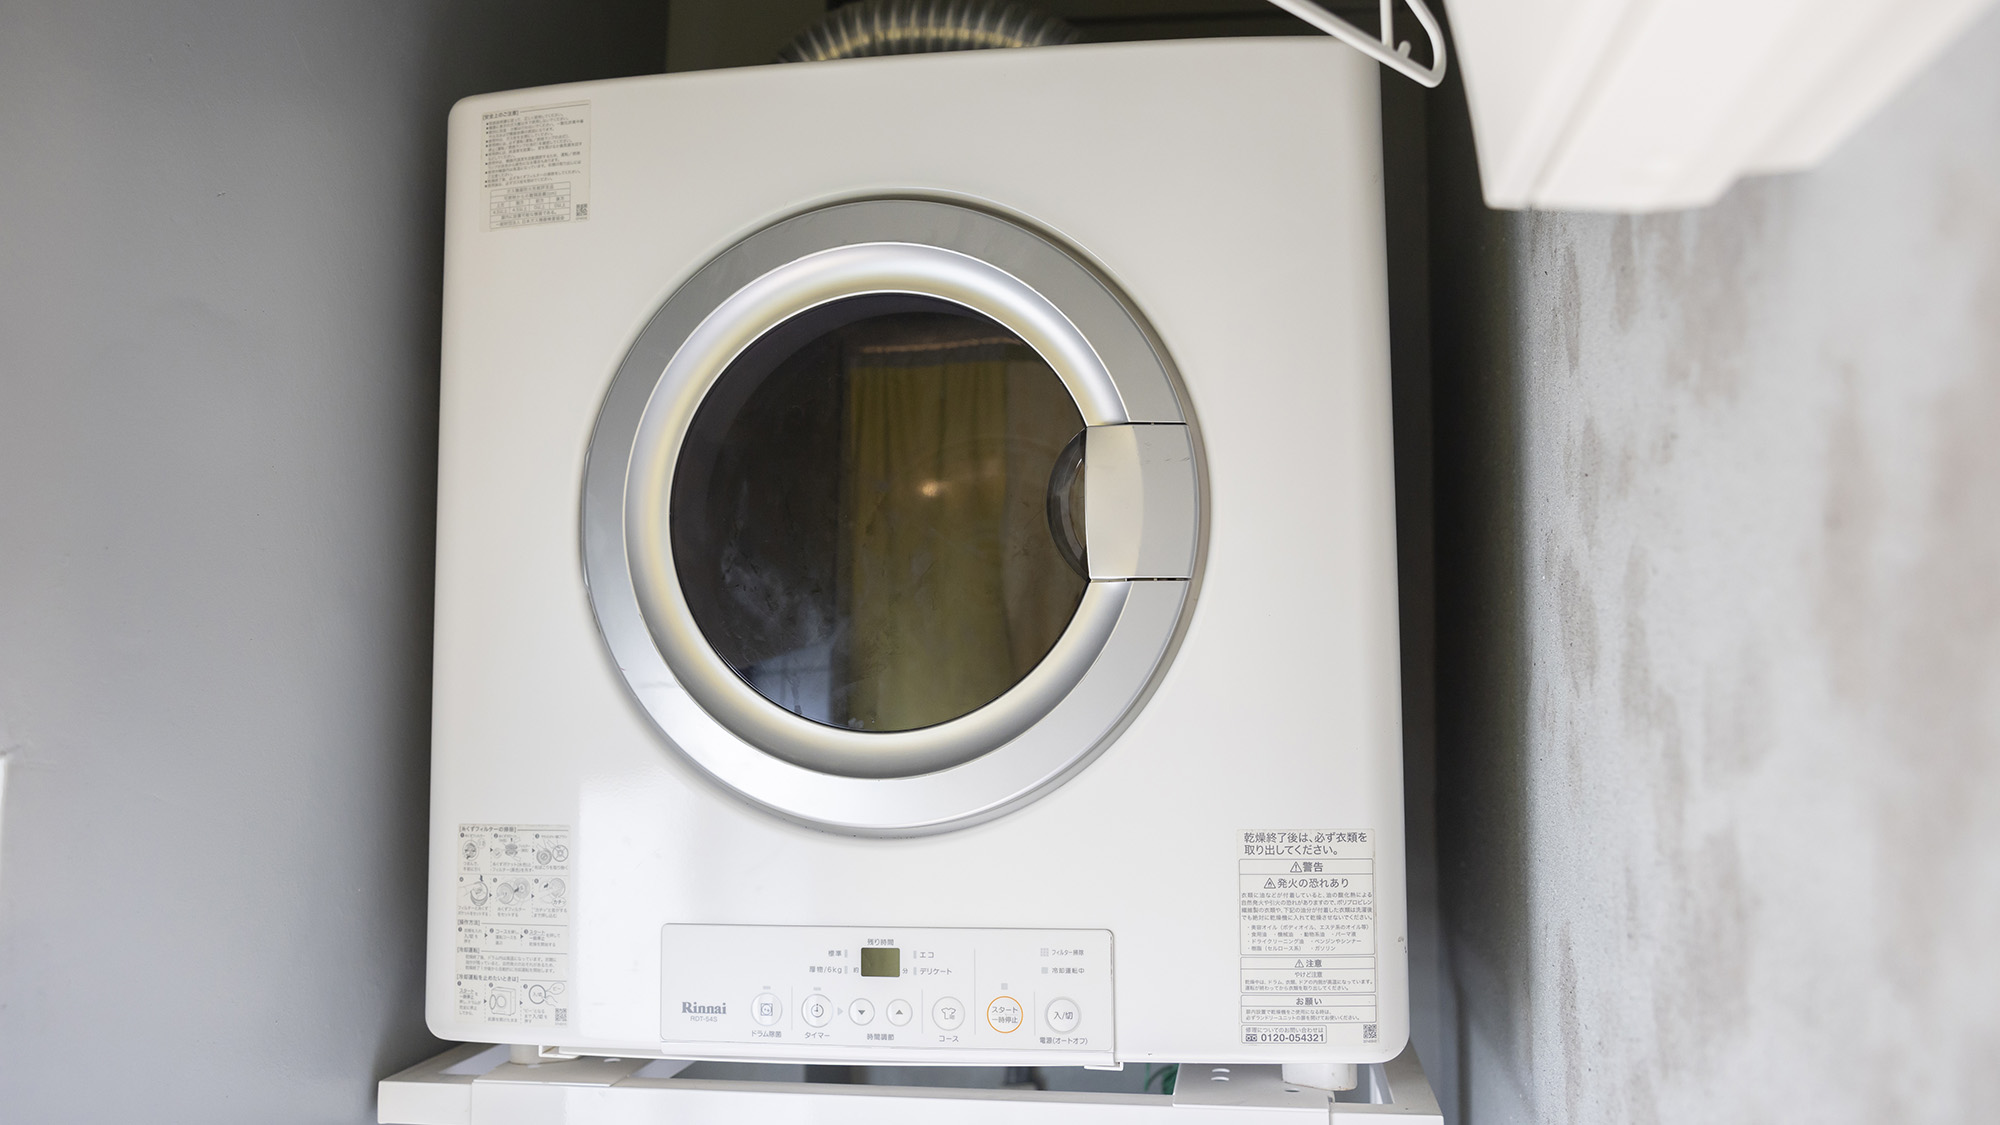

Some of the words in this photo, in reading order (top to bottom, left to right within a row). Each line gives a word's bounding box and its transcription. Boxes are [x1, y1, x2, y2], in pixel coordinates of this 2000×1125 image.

[1244, 832, 1367, 843] 乾燥終了後は、必ず衣類を
[1244, 844, 1338, 856] 取り出してください。
[1302, 862, 1324, 872] 警告
[1278, 878, 1349, 888] 発火の恐れあり
[1306, 959, 1322, 968] 注意
[809, 966, 842, 974] 厚物/6kg
[1296, 998, 1322, 1006] お願い
[682, 1000, 727, 1015] Rinnai
[992, 1006, 1018, 1014] スタート
[1054, 1010, 1074, 1020] 入/切
[992, 1016, 1018, 1024] 一時停止
[751, 1030, 782, 1038] ドラム除菌
[938, 1034, 958, 1042] コース
[1261, 1034, 1324, 1042] 0120-054321
[1040, 1036, 1088, 1045] 電源(オートオフ)
